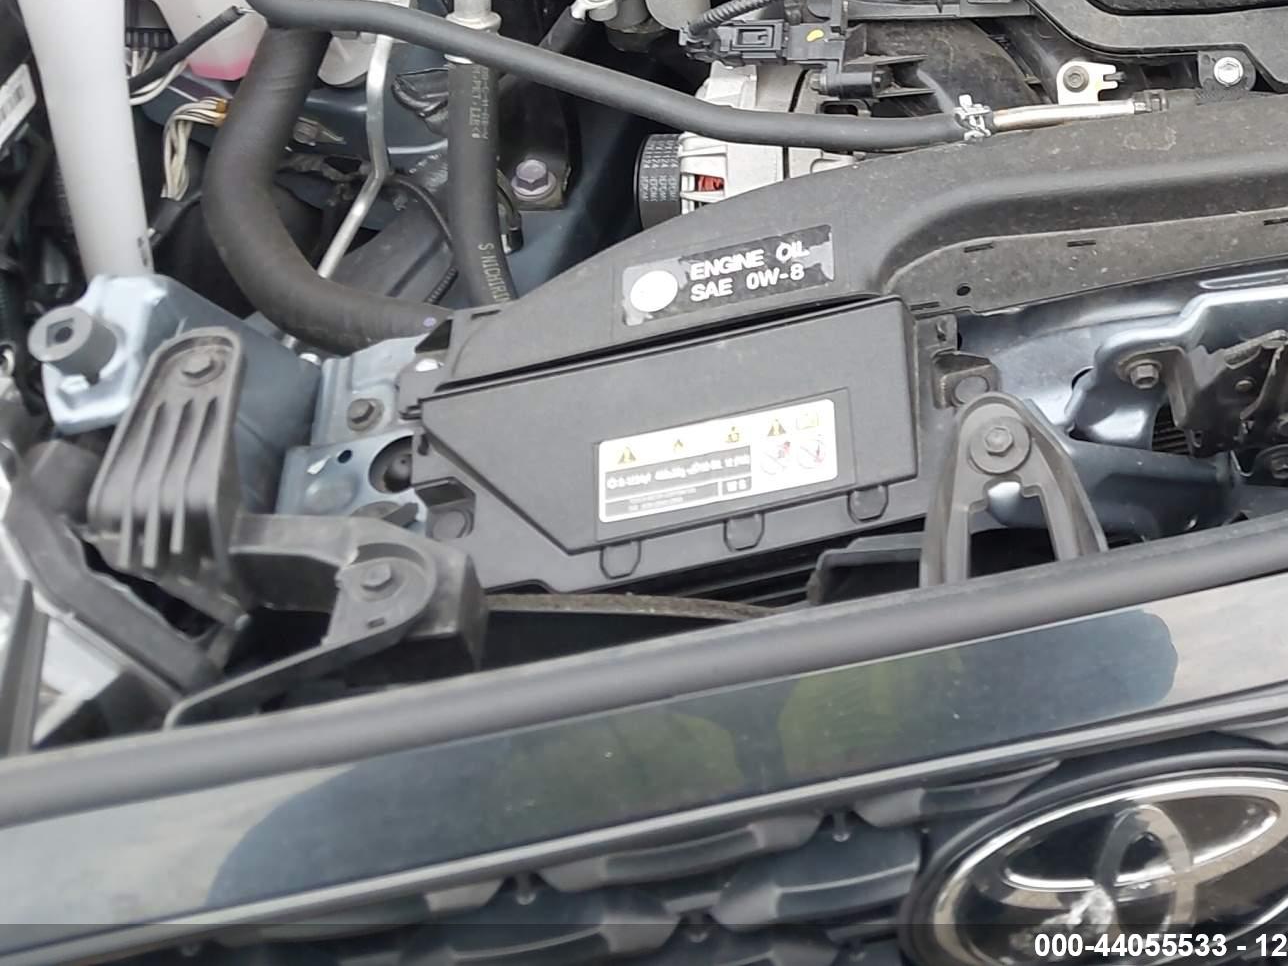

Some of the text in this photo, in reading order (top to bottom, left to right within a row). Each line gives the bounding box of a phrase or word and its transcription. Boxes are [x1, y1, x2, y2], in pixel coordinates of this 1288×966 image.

[689, 240, 811, 281] ENGINE OIL
[690, 263, 805, 302] SAE 0W-8
